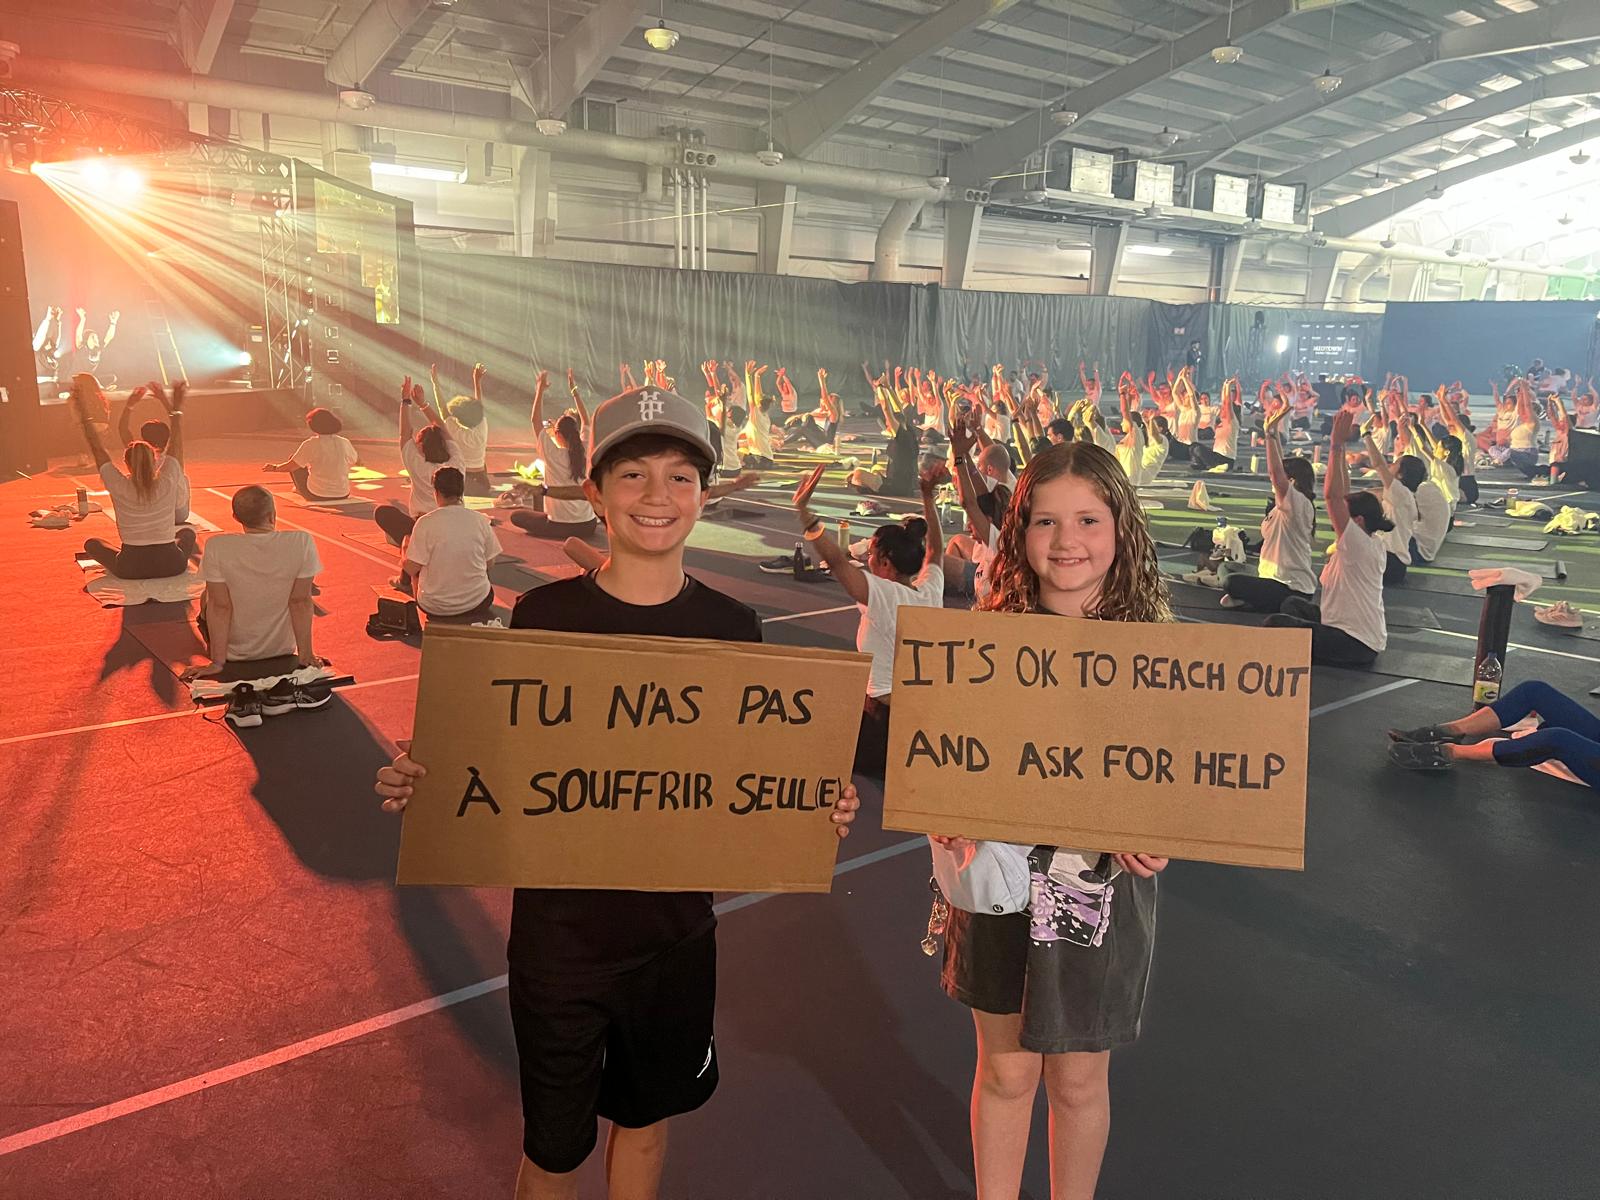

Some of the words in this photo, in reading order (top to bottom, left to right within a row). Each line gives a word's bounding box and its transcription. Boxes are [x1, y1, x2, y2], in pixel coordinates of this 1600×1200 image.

[902, 639, 996, 686] IT'S
[1015, 646, 1059, 689] OK
[1073, 650, 1117, 688] TO
[1132, 654, 1225, 692] REACH
[1237, 661, 1309, 698] OUT
[491, 678, 572, 727] TU
[607, 681, 703, 730] N'AS
[738, 685, 814, 725] PAS
[905, 730, 990, 773] AND
[1018, 741, 1084, 780] ASK
[1103, 745, 1175, 784] FOR
[1194, 751, 1286, 790] HELP
[456, 766, 501, 818] À
[523, 767, 713, 817] SOUFFRIR
[728, 773, 842, 816] SEUL(E)
